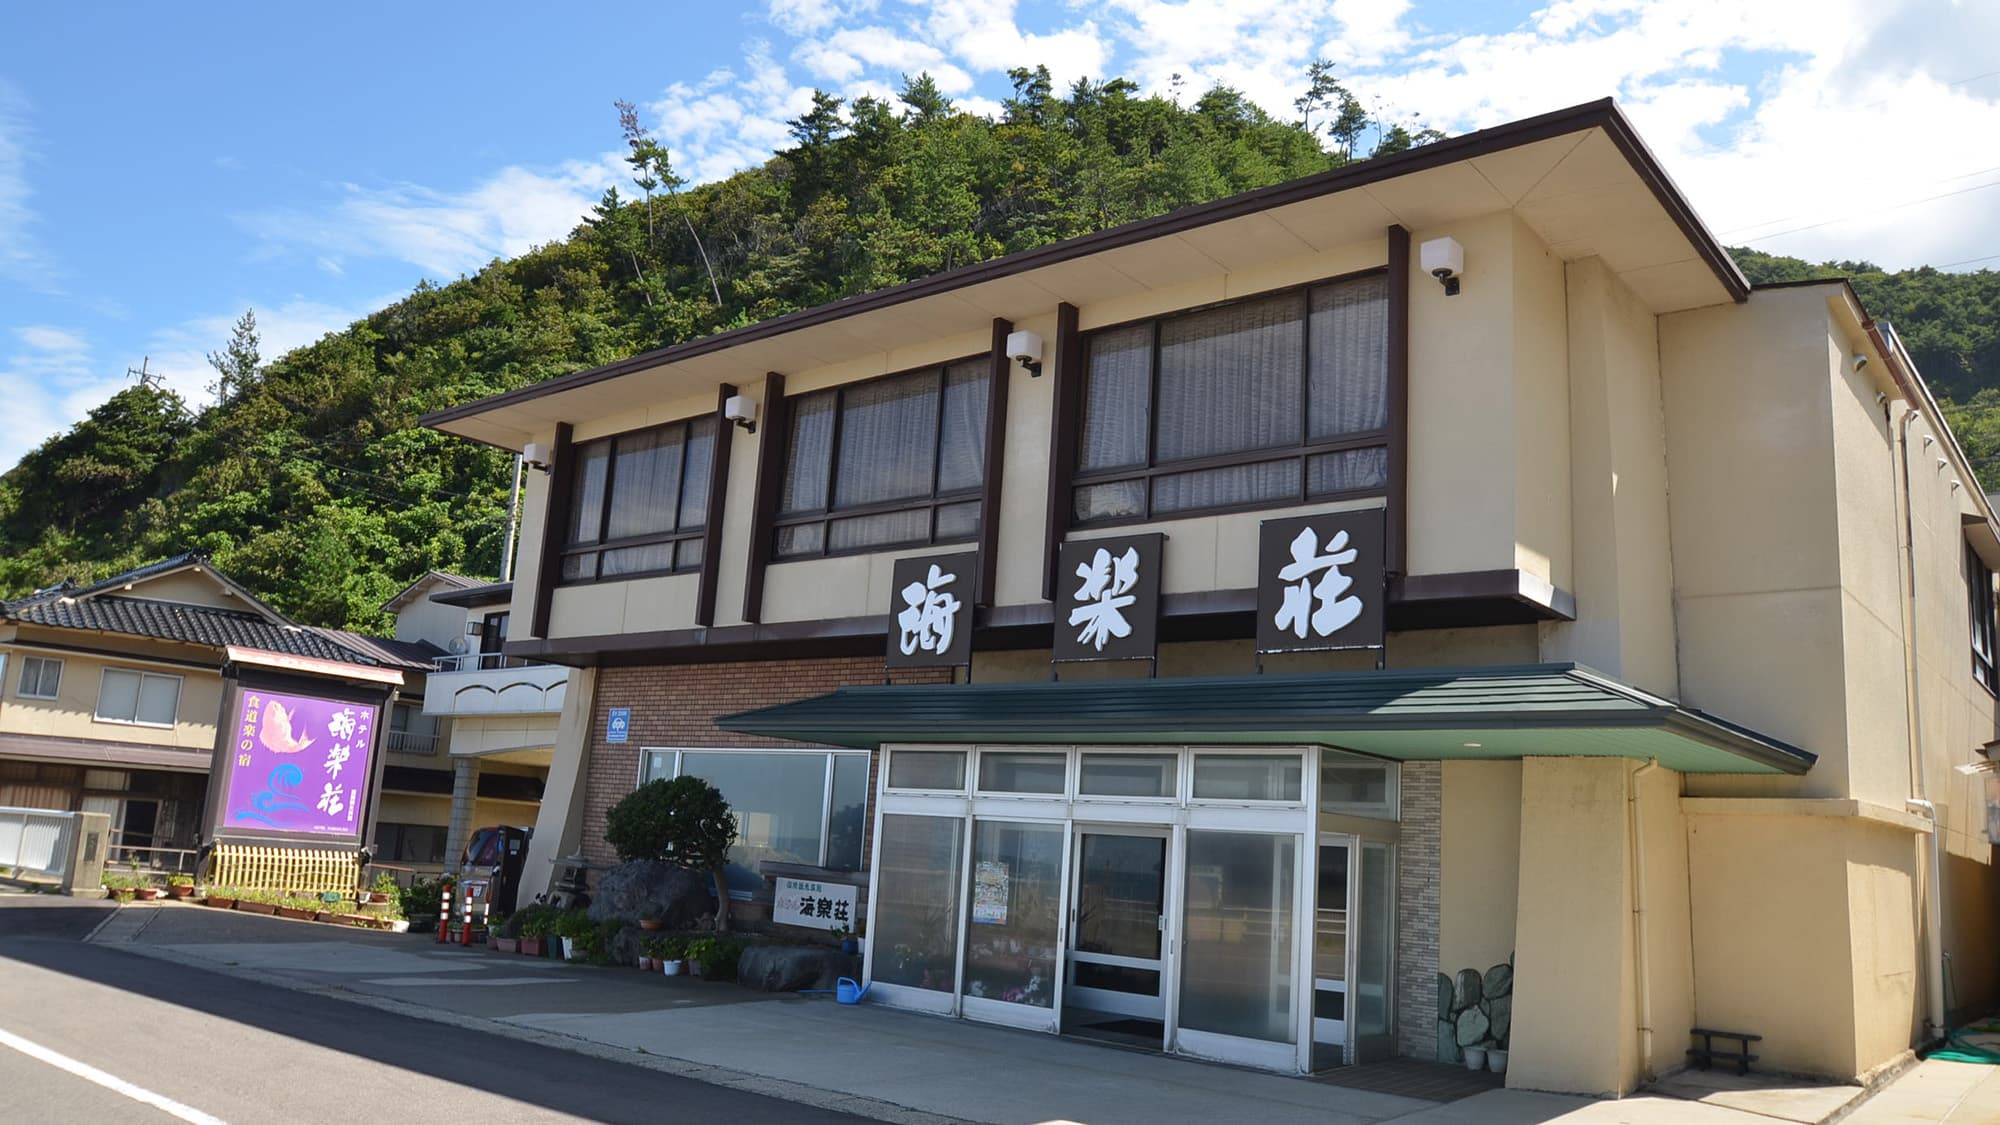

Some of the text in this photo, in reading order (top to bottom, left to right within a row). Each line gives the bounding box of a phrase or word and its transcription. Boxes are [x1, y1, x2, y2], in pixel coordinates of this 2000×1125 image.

[238, 695, 260, 767] 食道楽の宿
[355, 710, 370, 749] ホテル
